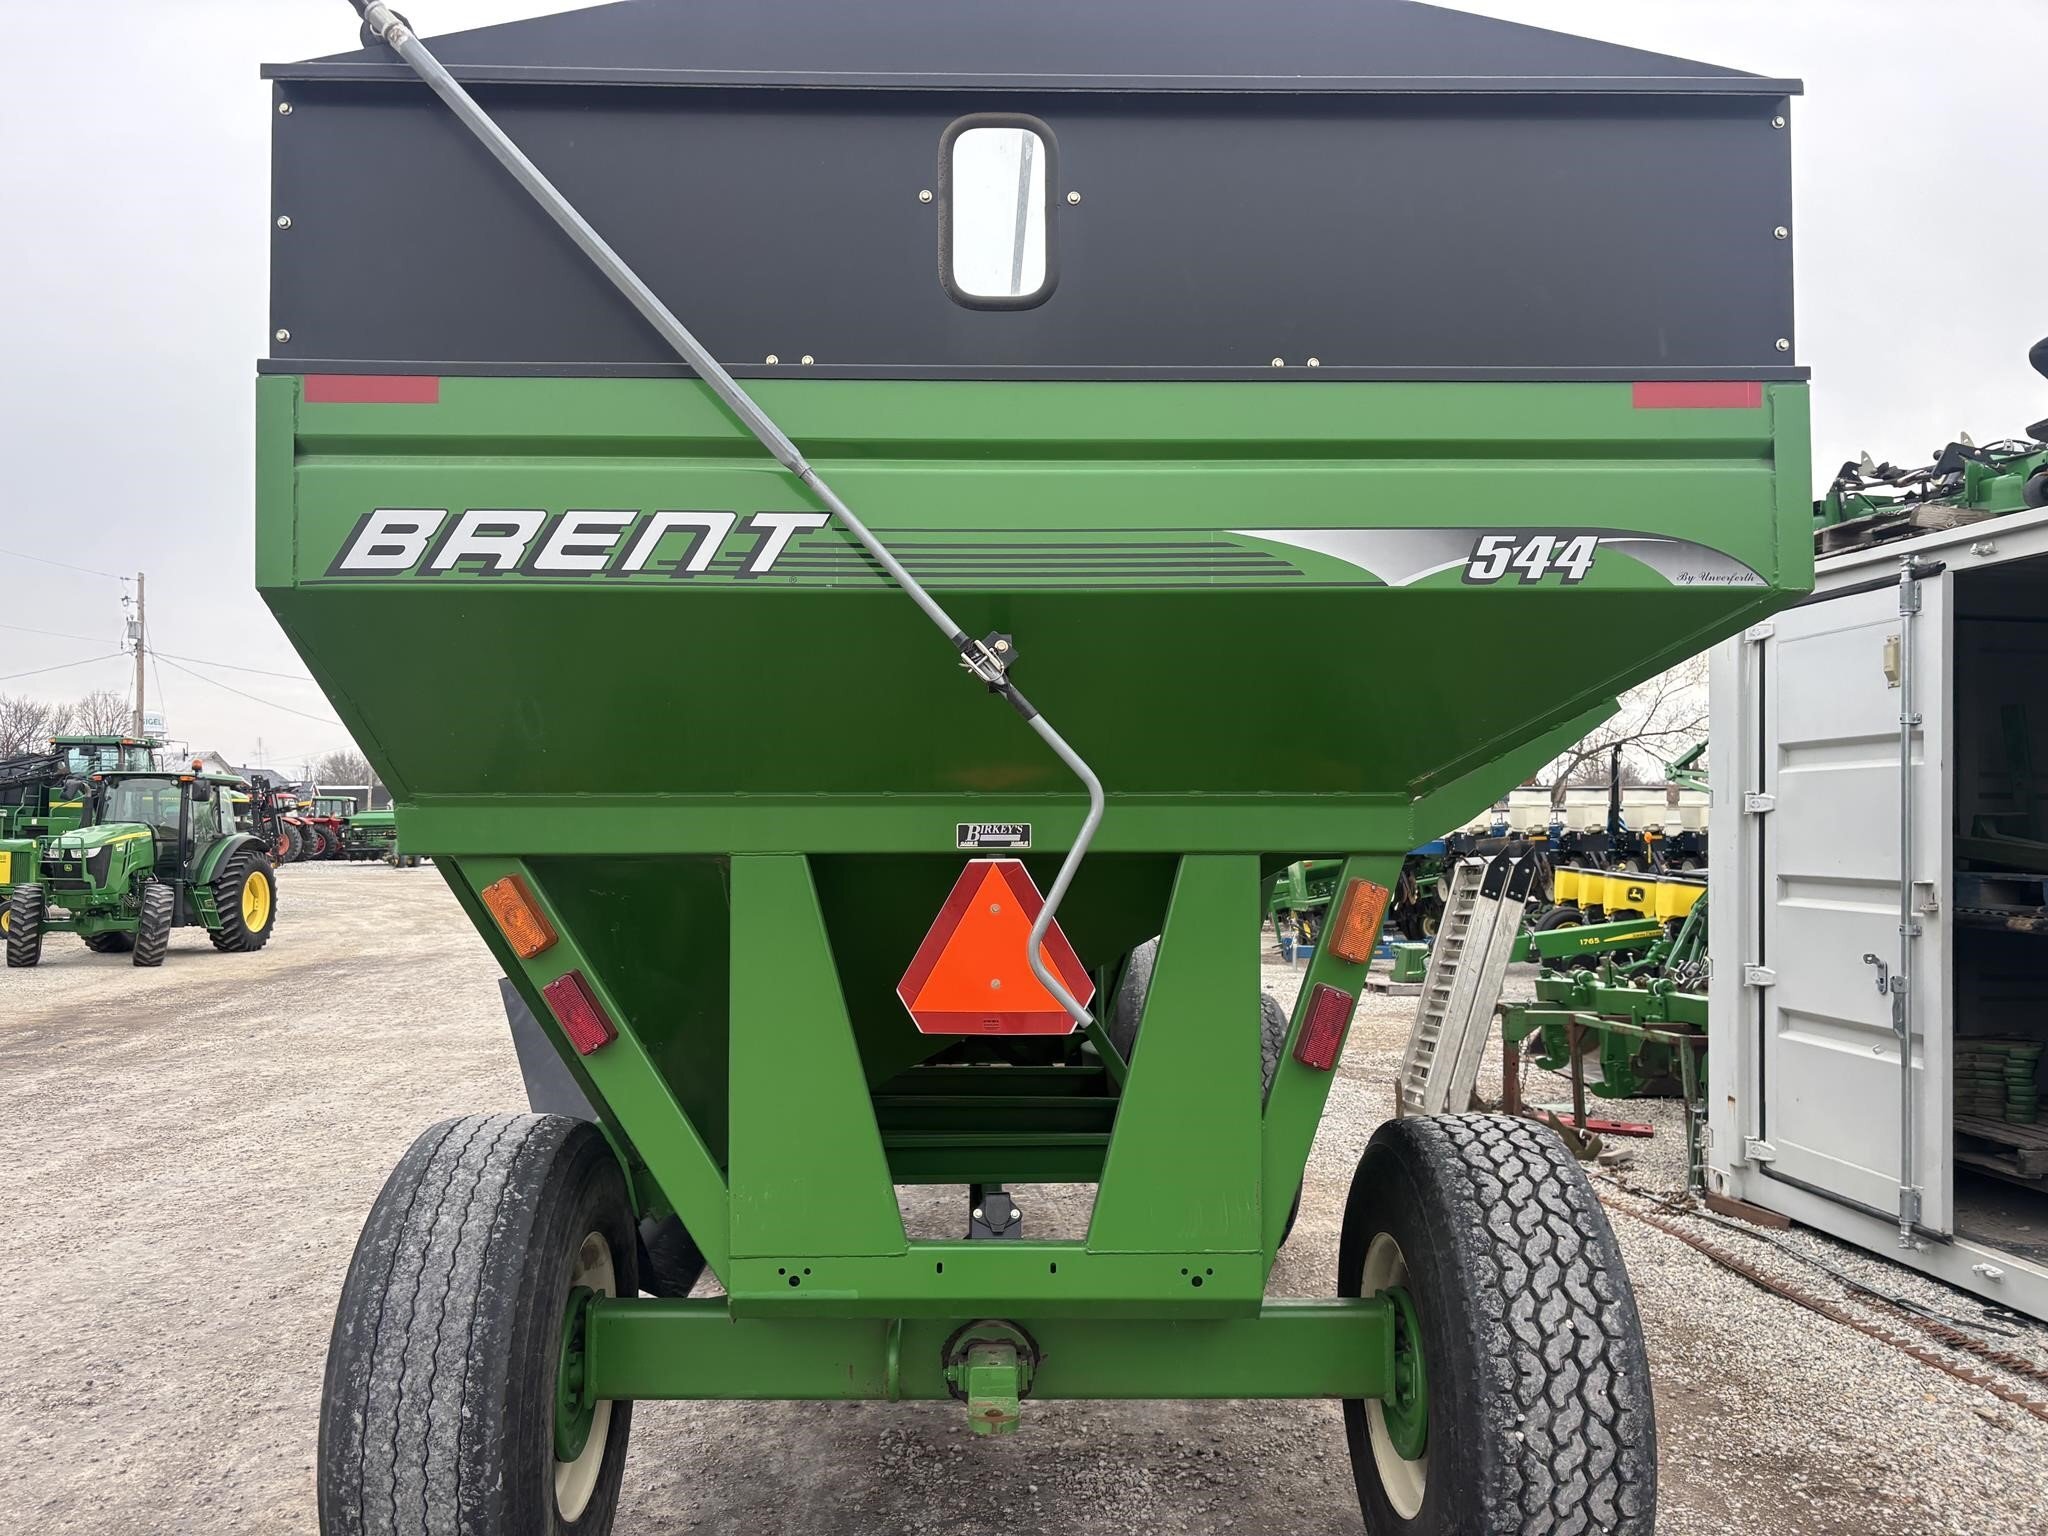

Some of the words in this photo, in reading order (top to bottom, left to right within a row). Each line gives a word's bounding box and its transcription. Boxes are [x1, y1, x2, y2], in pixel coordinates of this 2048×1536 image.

[324, 508, 833, 579] BRENT
[1461, 534, 1600, 585] 544
[1676, 570, 1696, 585] By
[1699, 570, 1754, 585] Unverferth
[143, 718, 162, 726] IGEL
[965, 824, 1024, 842] BIRKEY'S
[1580, 937, 1600, 946] 1765
